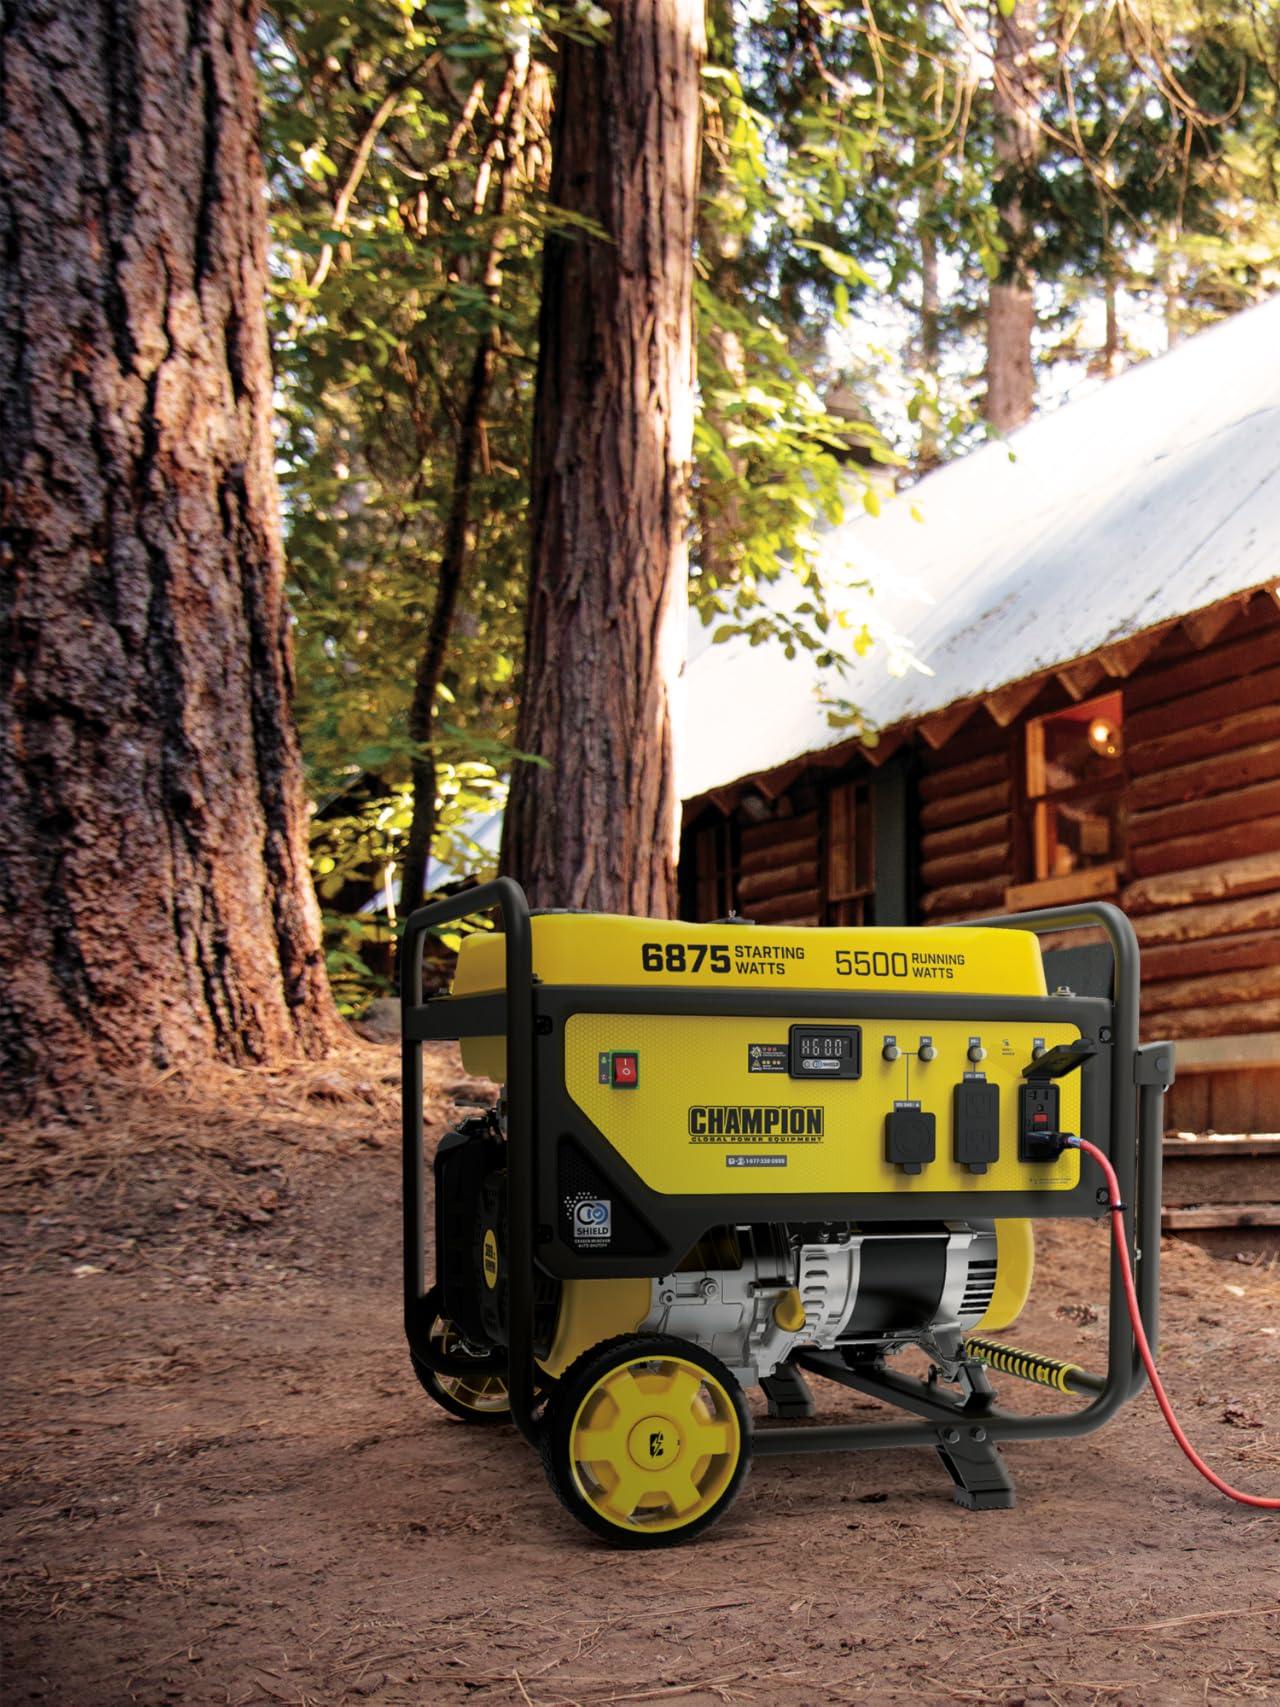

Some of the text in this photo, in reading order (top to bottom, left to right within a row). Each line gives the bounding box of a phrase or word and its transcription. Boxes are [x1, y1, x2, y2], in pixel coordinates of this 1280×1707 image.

[642, 943, 731, 973] 6875
[735, 945, 805, 960] STARTING
[911, 952, 965, 966] RUNNING
[735, 961, 785, 975] WATTS
[835, 950, 908, 977] 5500
[912, 966, 954, 979] WATTS
[689, 1106, 824, 1136] CHAMPION
[576, 1227, 609, 1236] SHIELD
